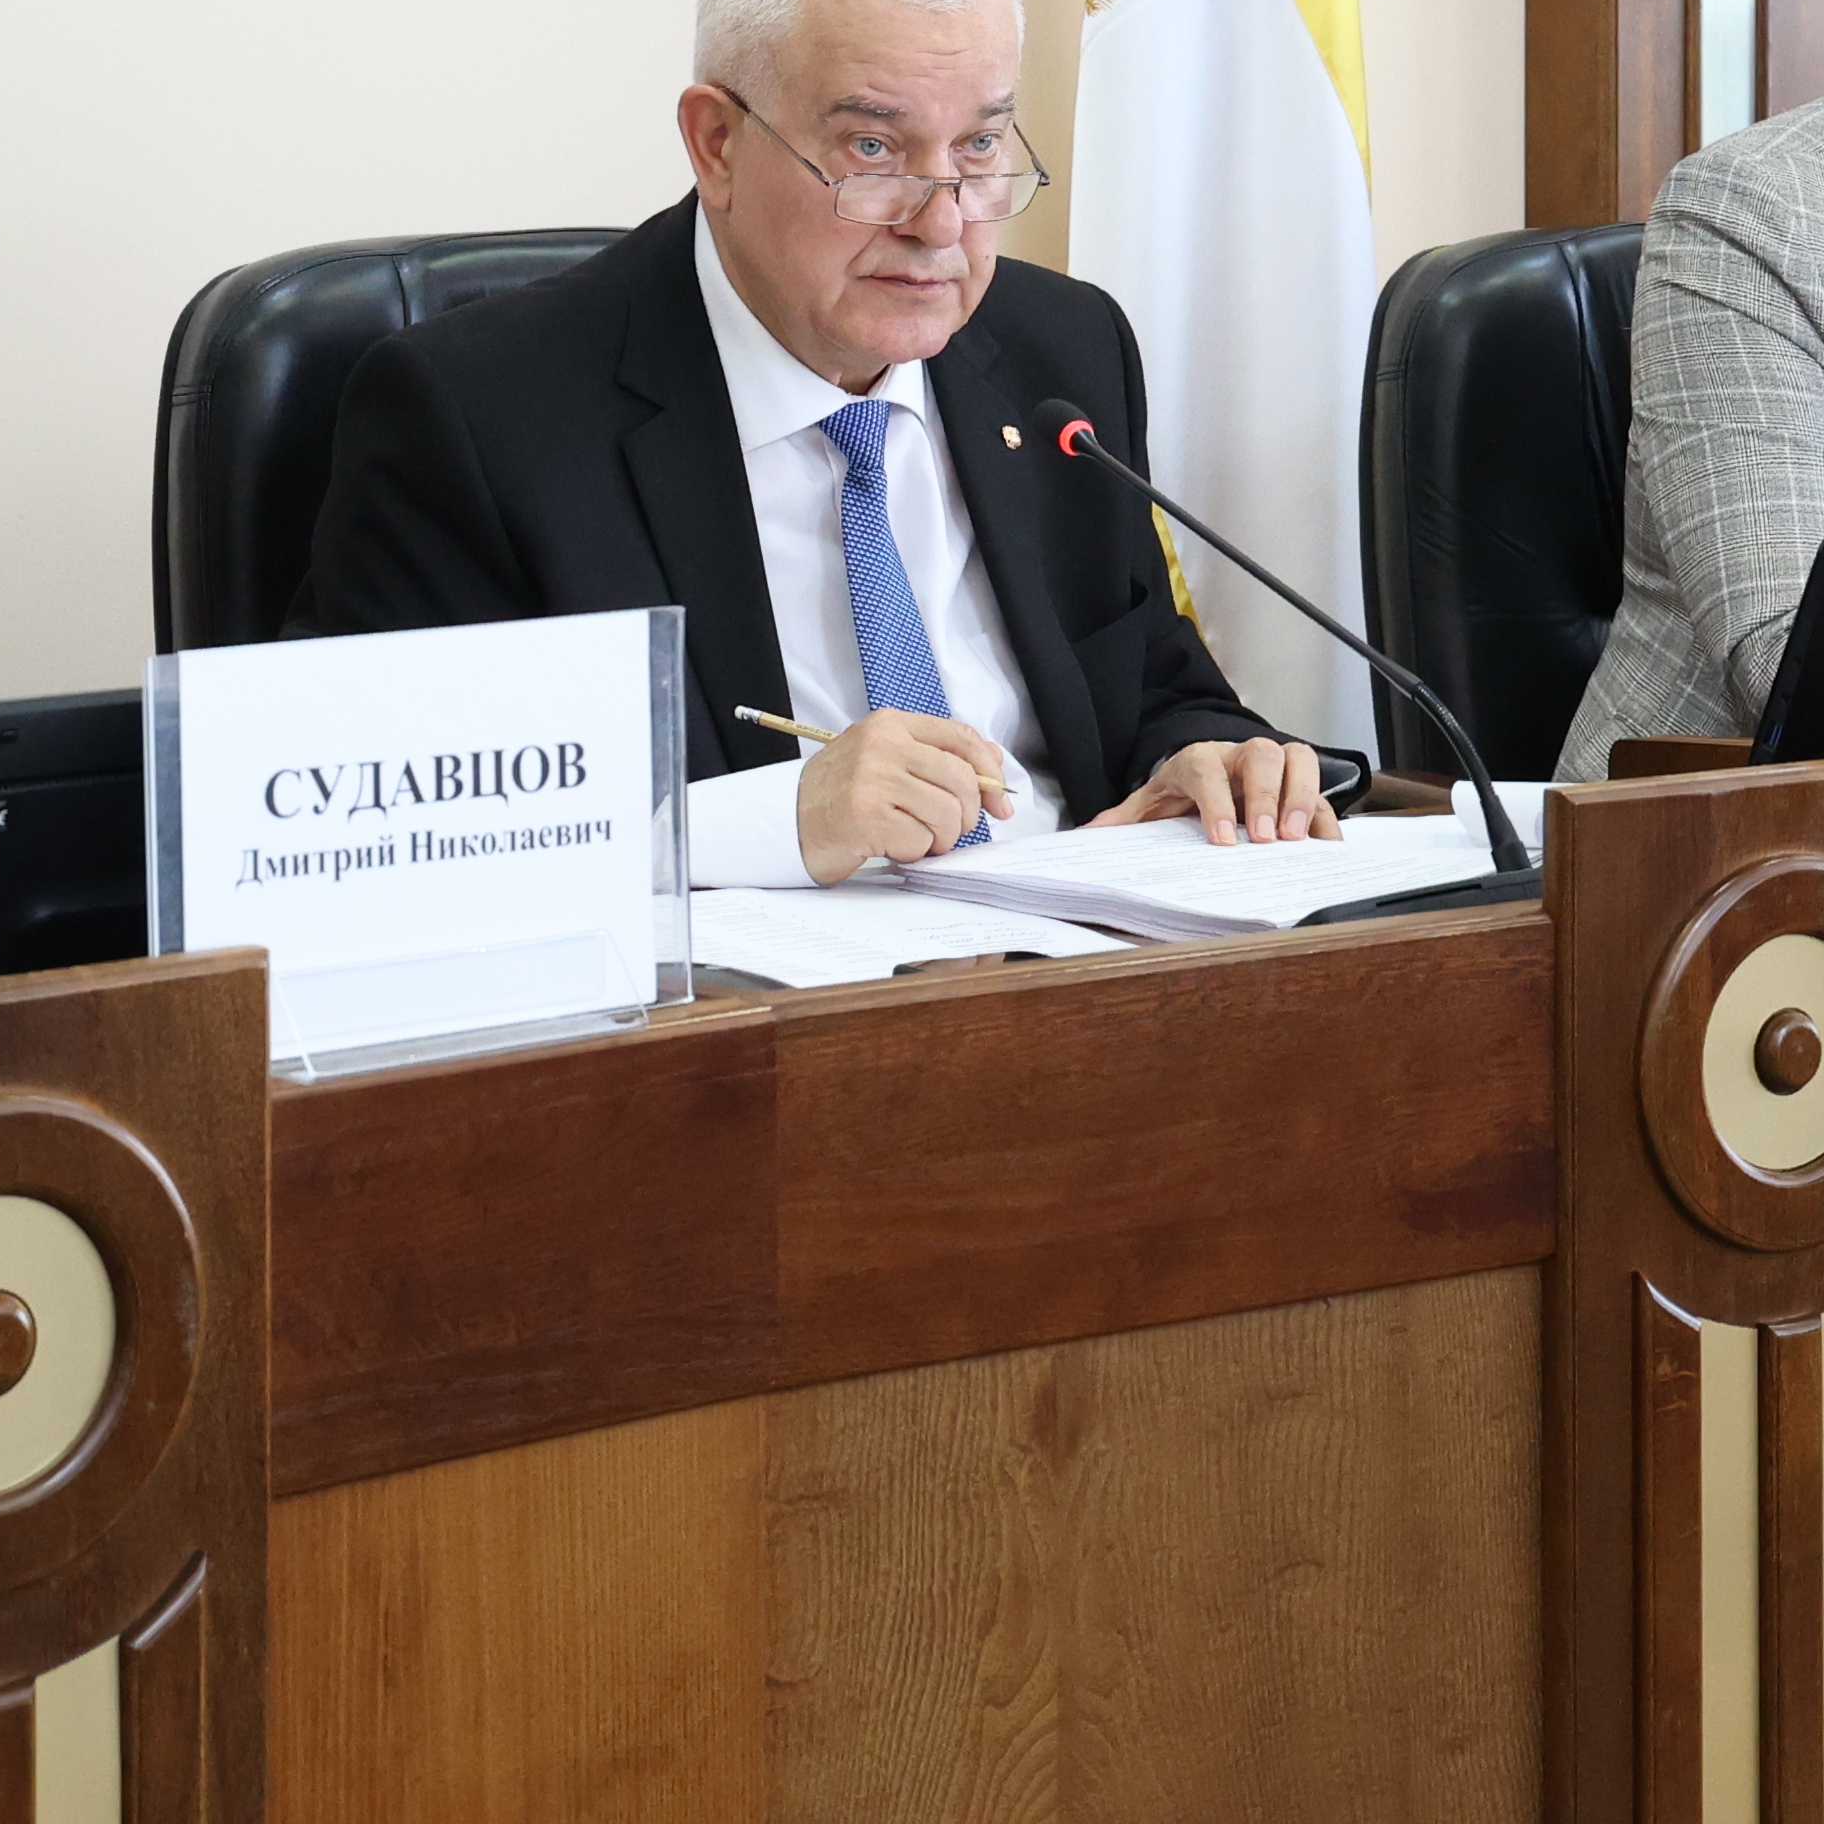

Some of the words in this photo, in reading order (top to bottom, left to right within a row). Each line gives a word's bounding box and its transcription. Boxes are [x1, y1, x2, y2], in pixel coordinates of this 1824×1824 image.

[263, 741, 588, 824] СУДАВЦОВ
[234, 835, 397, 893] Дмитрий
[408, 818, 614, 865] Николаевич
